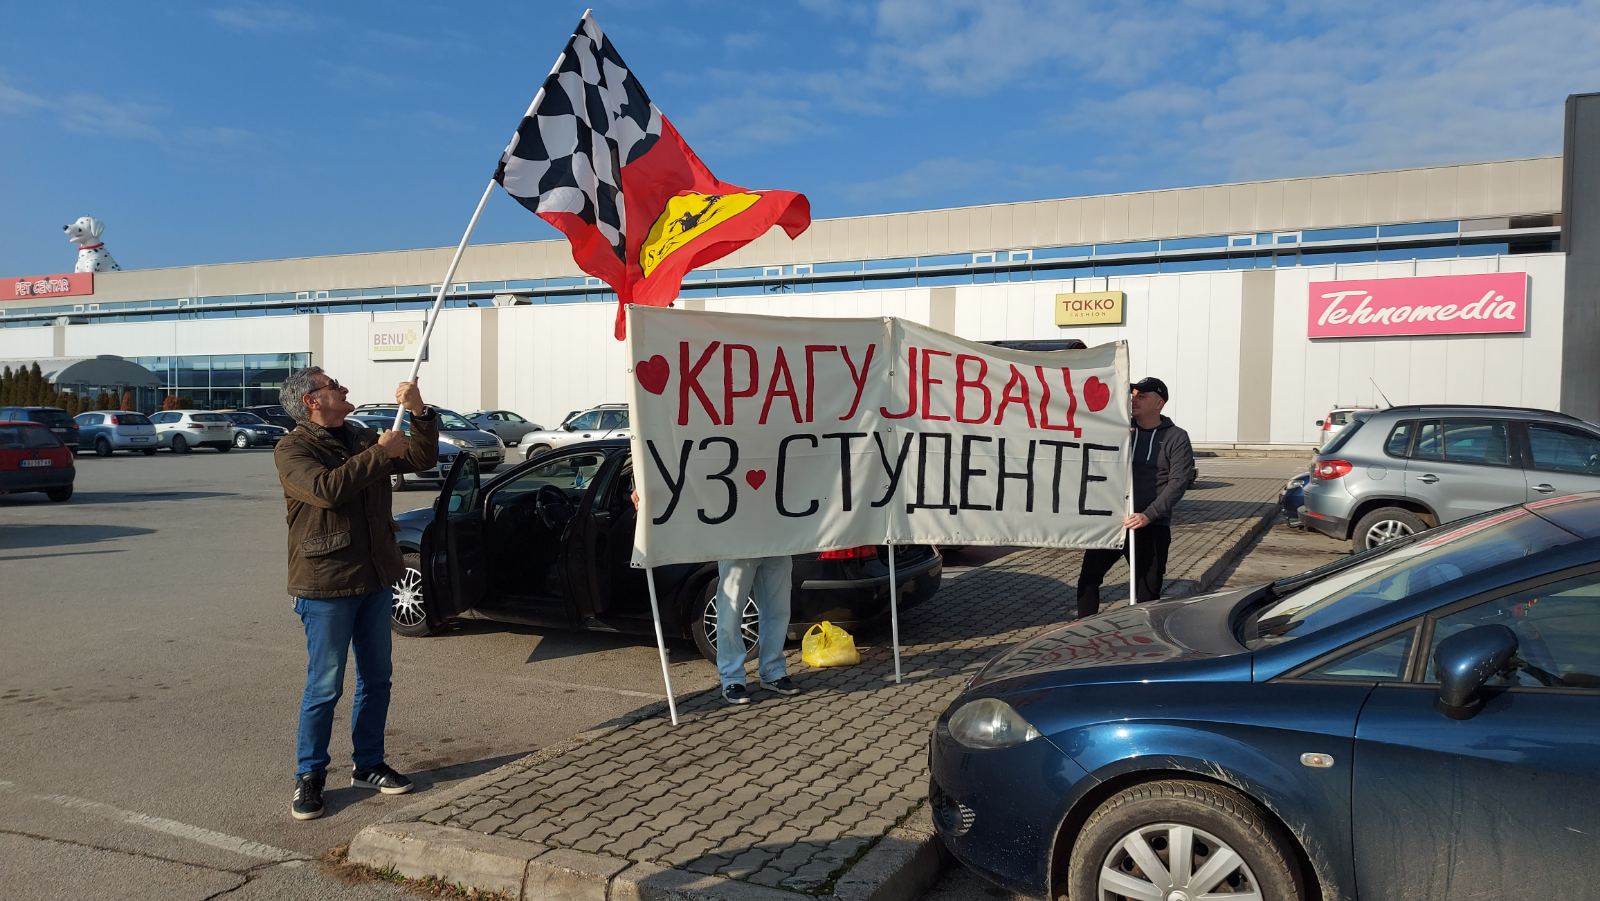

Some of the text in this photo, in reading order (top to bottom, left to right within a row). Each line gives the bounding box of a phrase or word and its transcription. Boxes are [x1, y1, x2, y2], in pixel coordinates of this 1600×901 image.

[15, 278, 70, 296] PET CENTAR
[1317, 290, 1516, 326] Tehnomedia
[374, 333, 405, 346] BENU
[647, 432, 1119, 525] УЗ СТУДЕНТЕ
